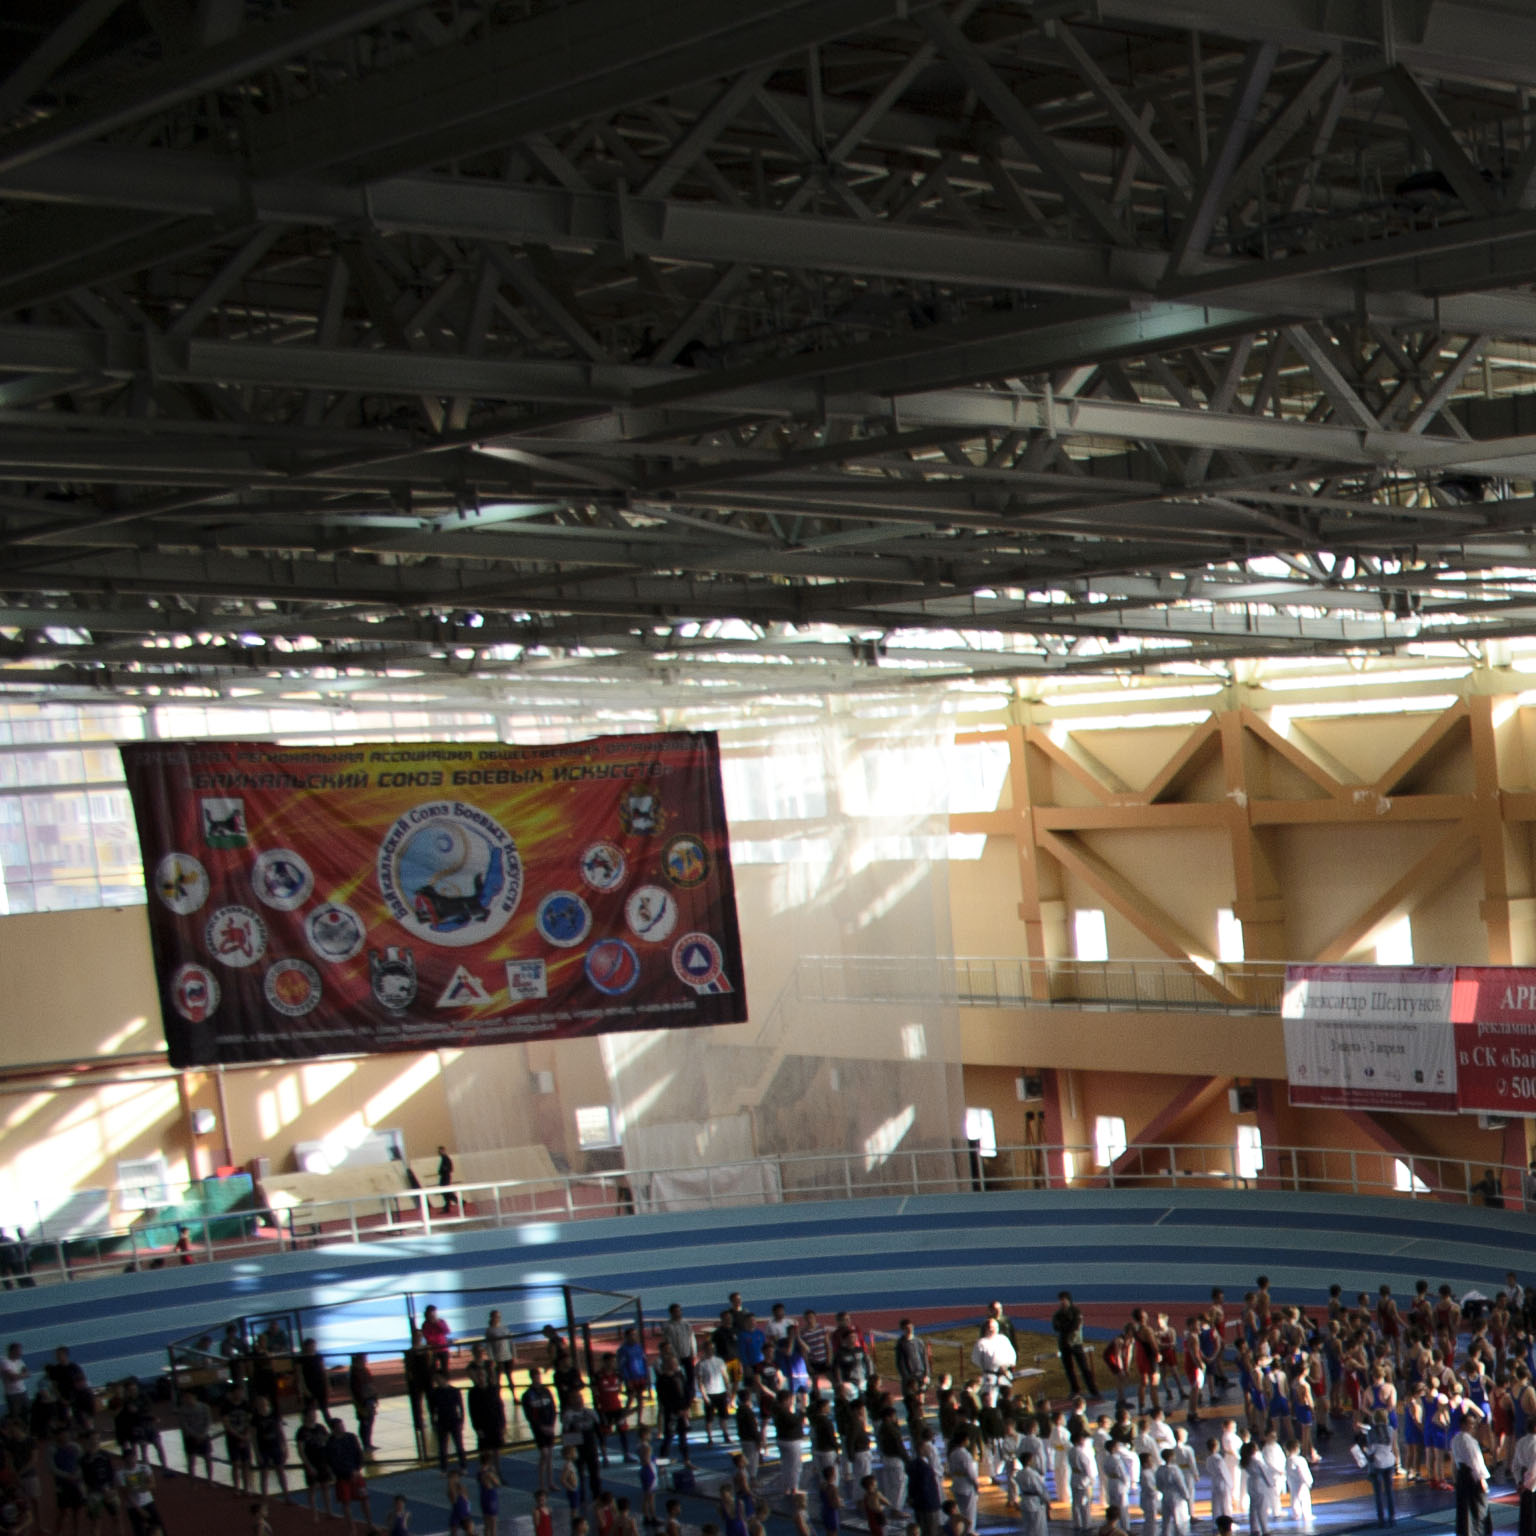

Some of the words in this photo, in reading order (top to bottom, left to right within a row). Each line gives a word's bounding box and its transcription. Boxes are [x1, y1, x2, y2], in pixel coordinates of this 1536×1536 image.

[378, 768, 443, 788] СОЮЗ
[452, 767, 544, 786] БОЕВЫХ
[410, 804, 449, 824] Союз
[453, 802, 507, 841] Боевых
[1459, 1053, 1470, 1066] в
[1472, 1046, 1498, 1068] СК
